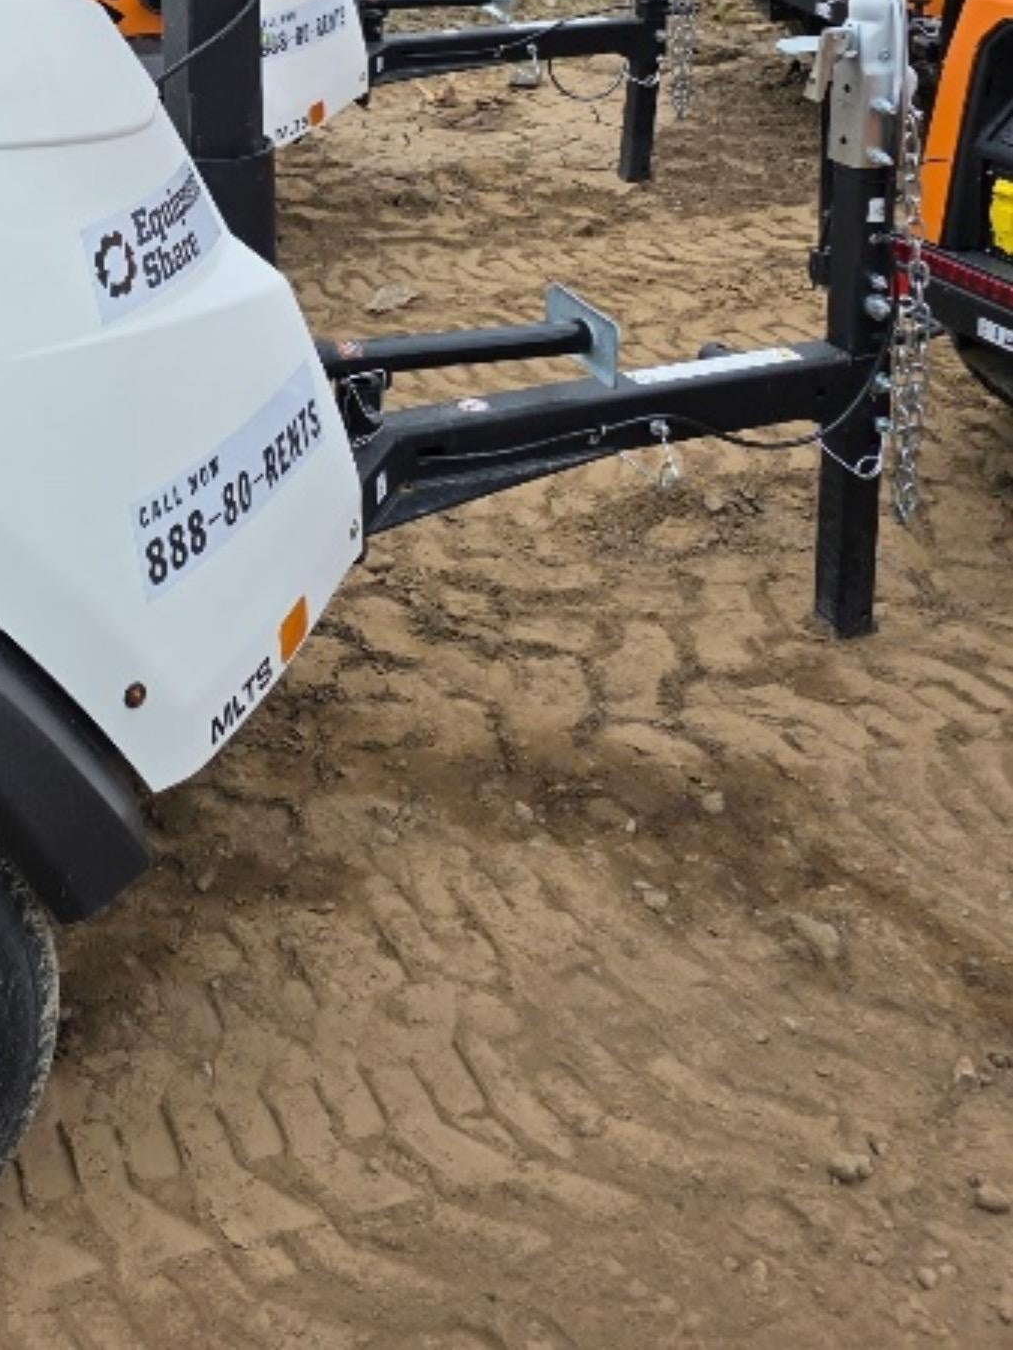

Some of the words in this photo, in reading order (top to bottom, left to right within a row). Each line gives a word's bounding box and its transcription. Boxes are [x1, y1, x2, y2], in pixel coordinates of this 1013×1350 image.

[142, 231, 200, 288] Share
[139, 486, 183, 528] CALL
[145, 399, 321, 586] 888-80-RENTS
